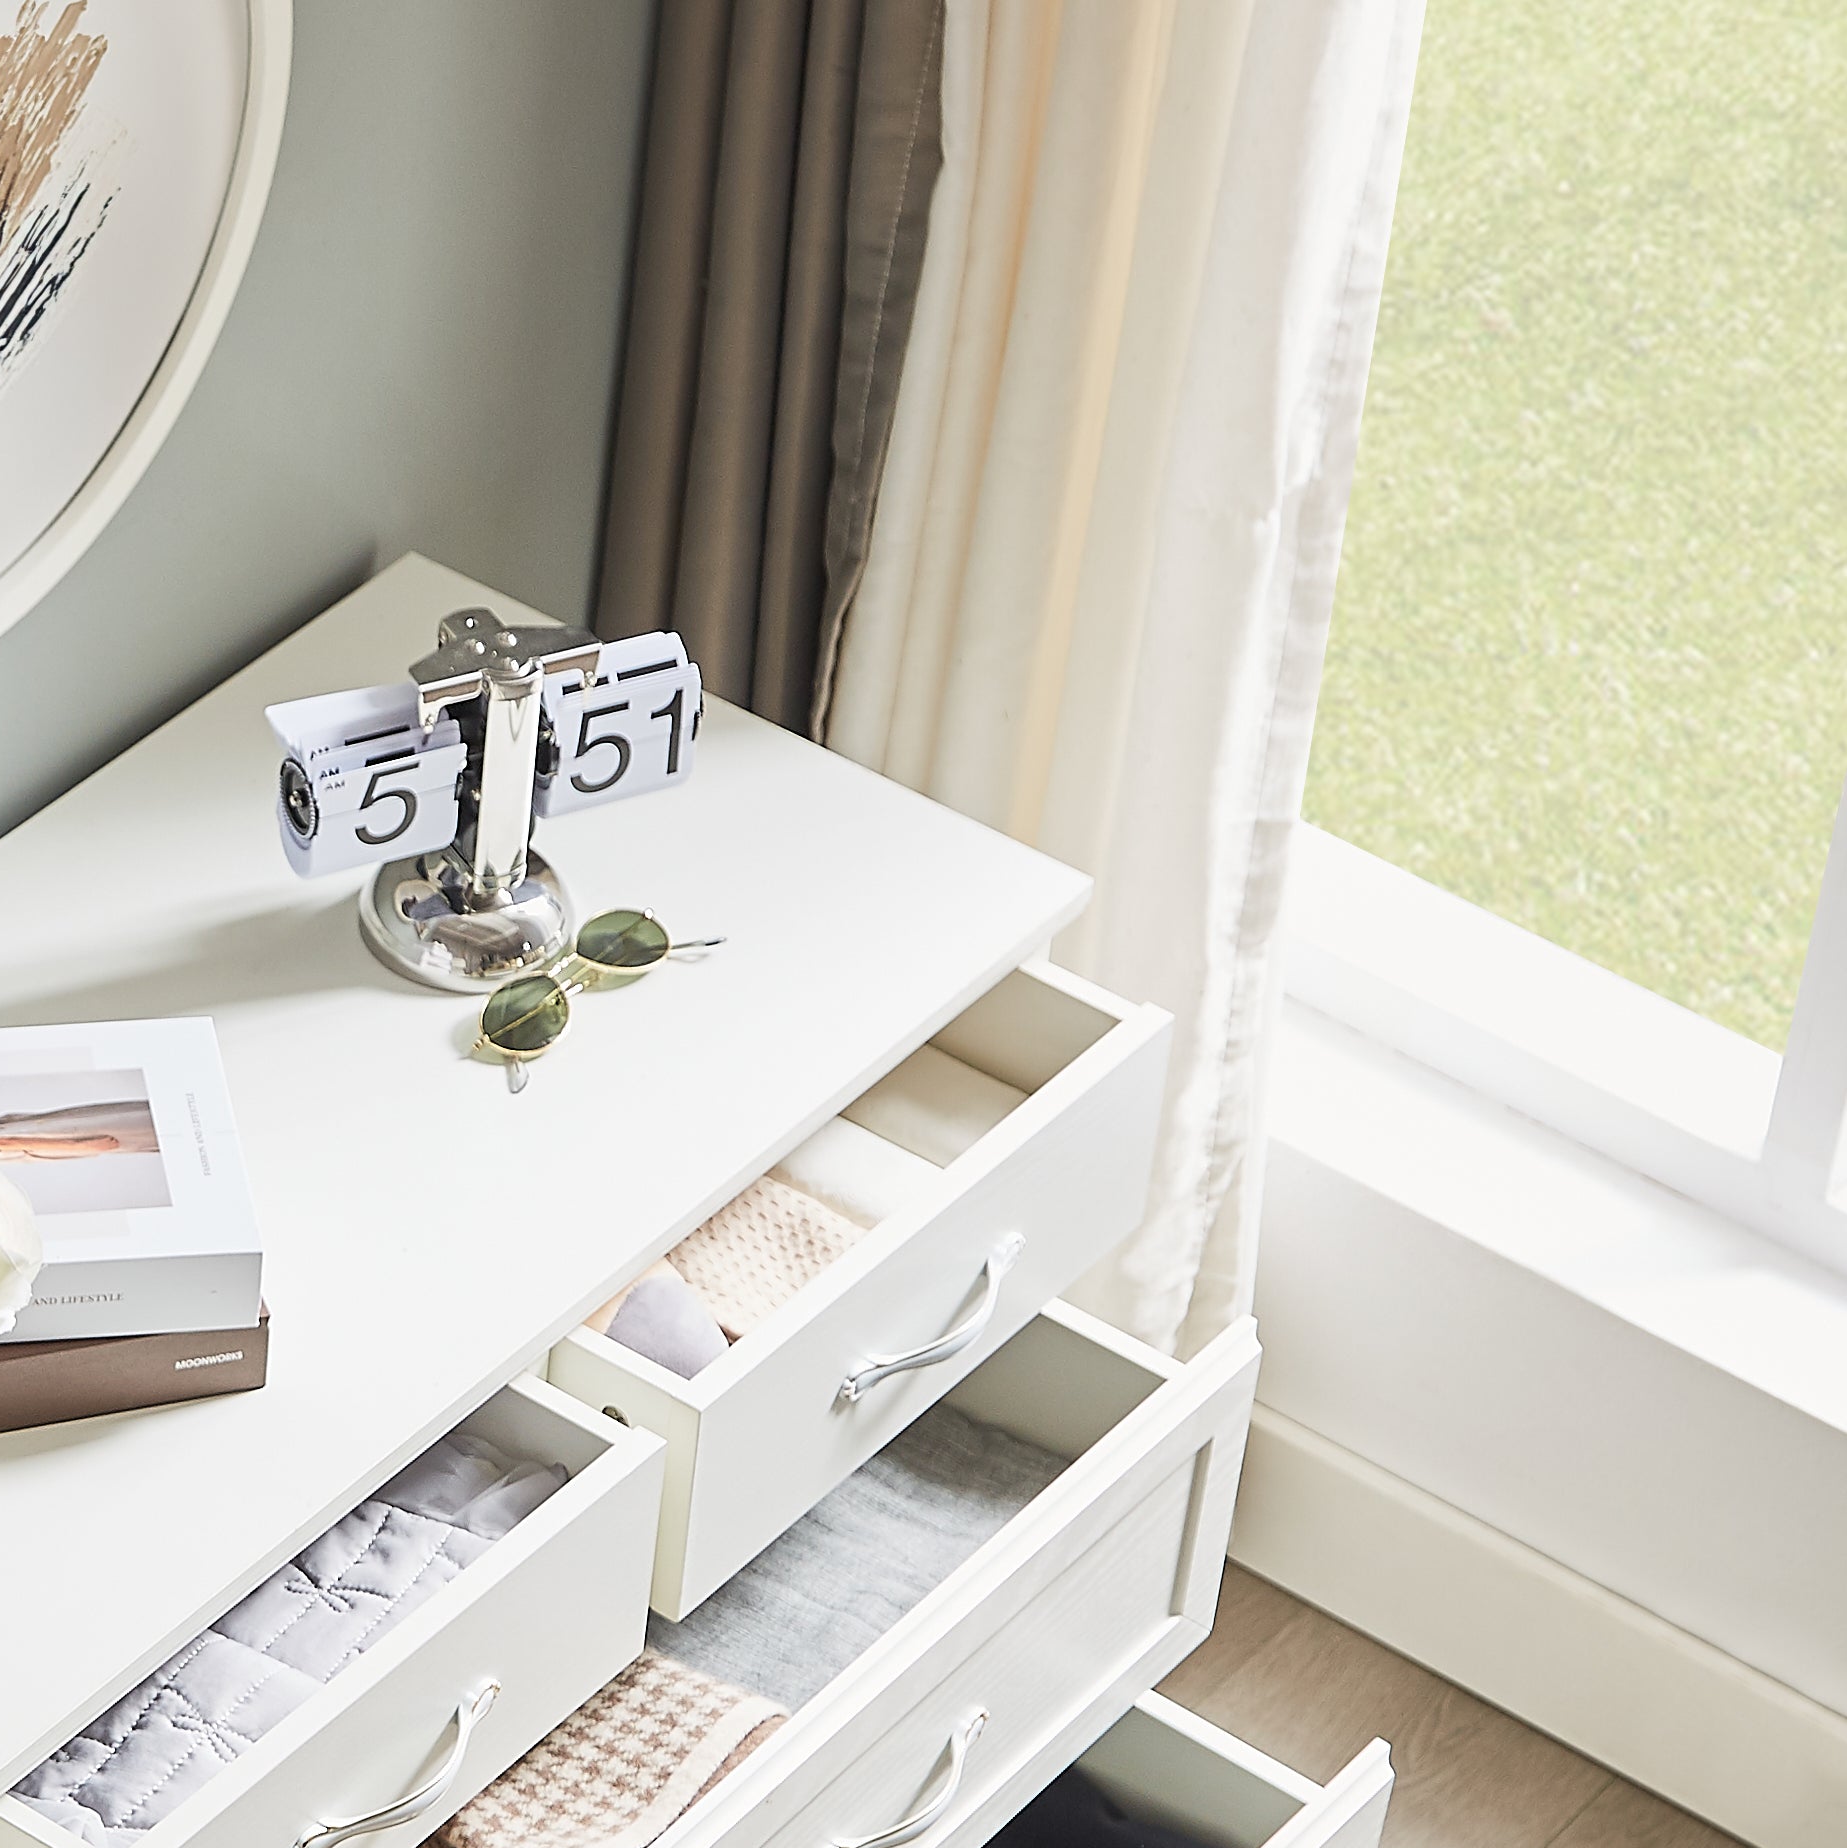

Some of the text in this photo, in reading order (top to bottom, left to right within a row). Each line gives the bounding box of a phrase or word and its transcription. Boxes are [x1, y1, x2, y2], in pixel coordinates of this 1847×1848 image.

[320, 766, 340, 780] AM
[354, 688, 684, 845] 5 51
[33, 1292, 125, 1306] AND LIFESTYLE
[174, 1350, 244, 1371] MOONWORKS
